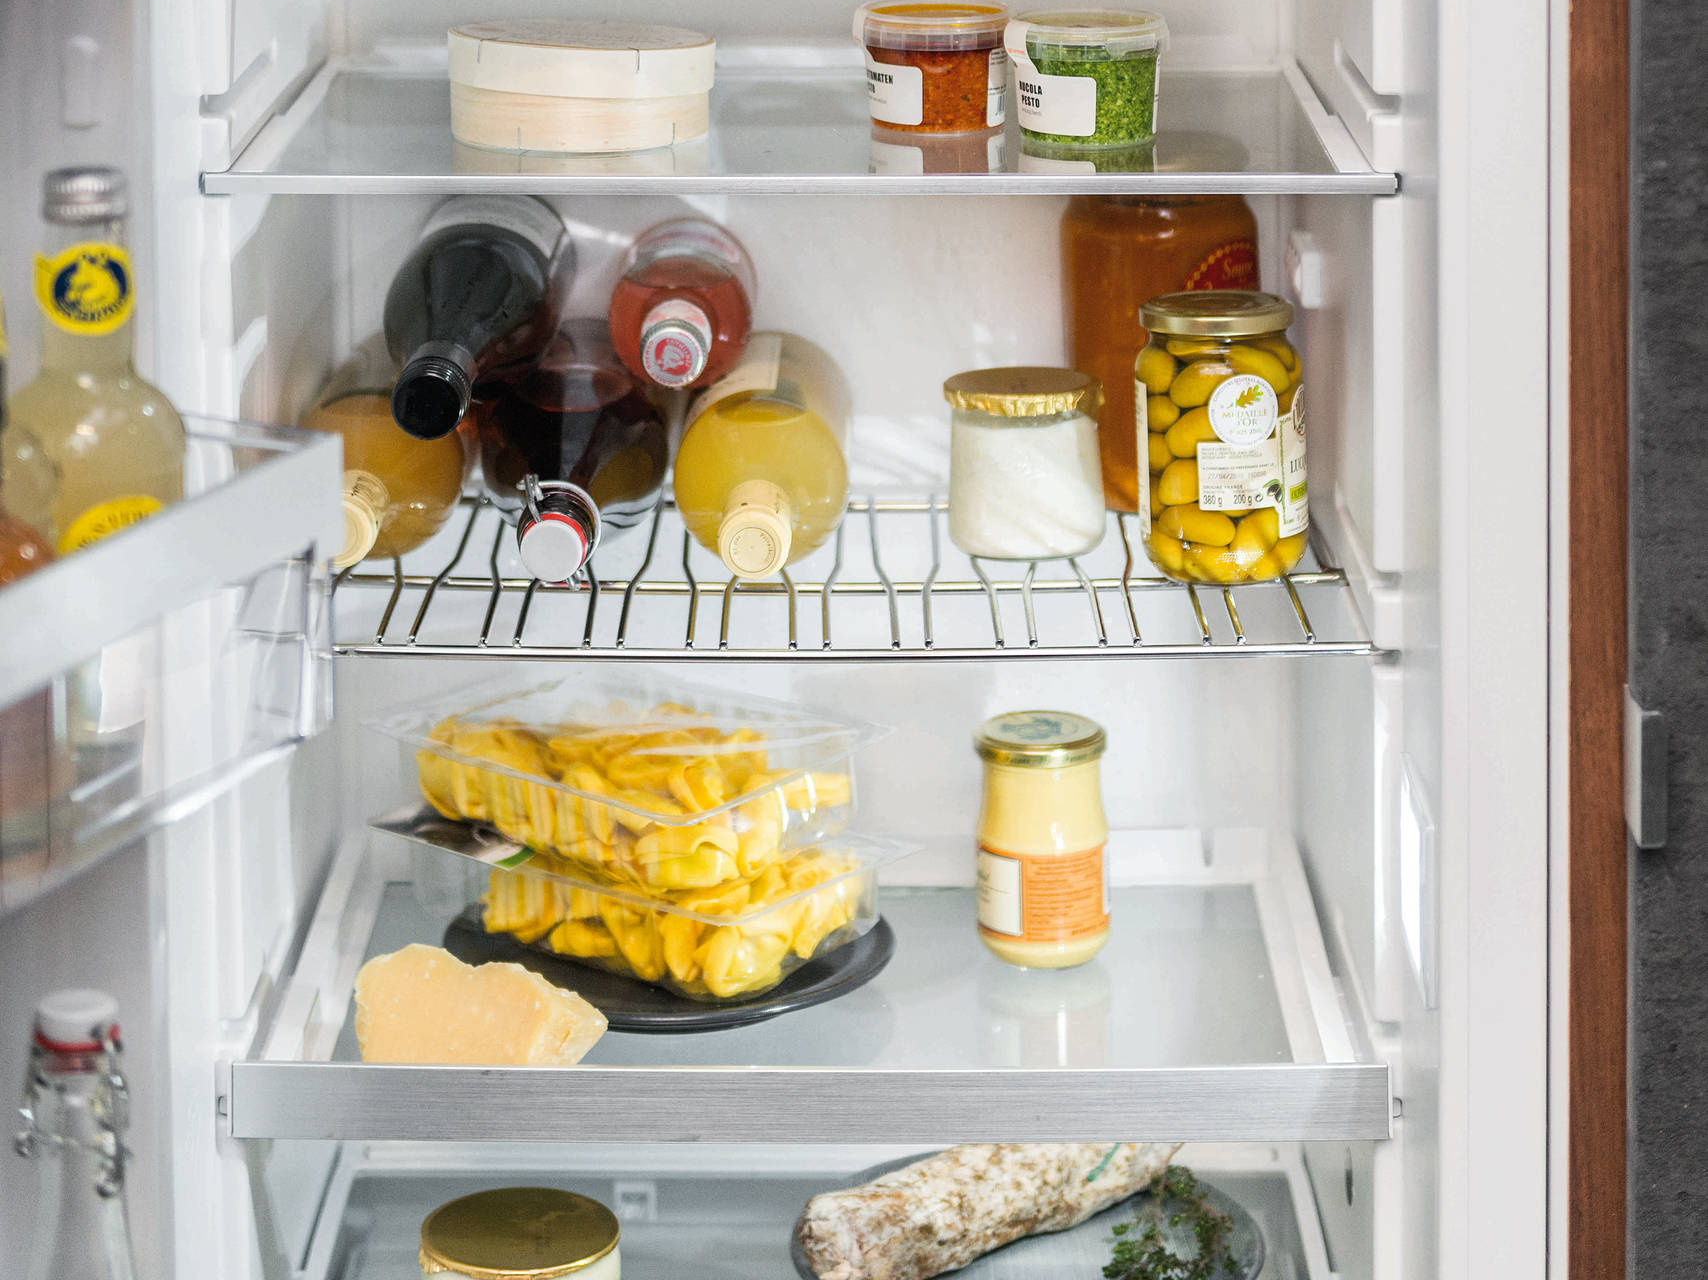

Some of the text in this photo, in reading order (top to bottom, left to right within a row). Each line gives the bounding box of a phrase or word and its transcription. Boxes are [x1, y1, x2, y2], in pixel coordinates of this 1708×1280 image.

[1019, 80, 1043, 96] RUCOLA
[1021, 94, 1040, 109] PESTO
[1233, 493, 1247, 505] 200
